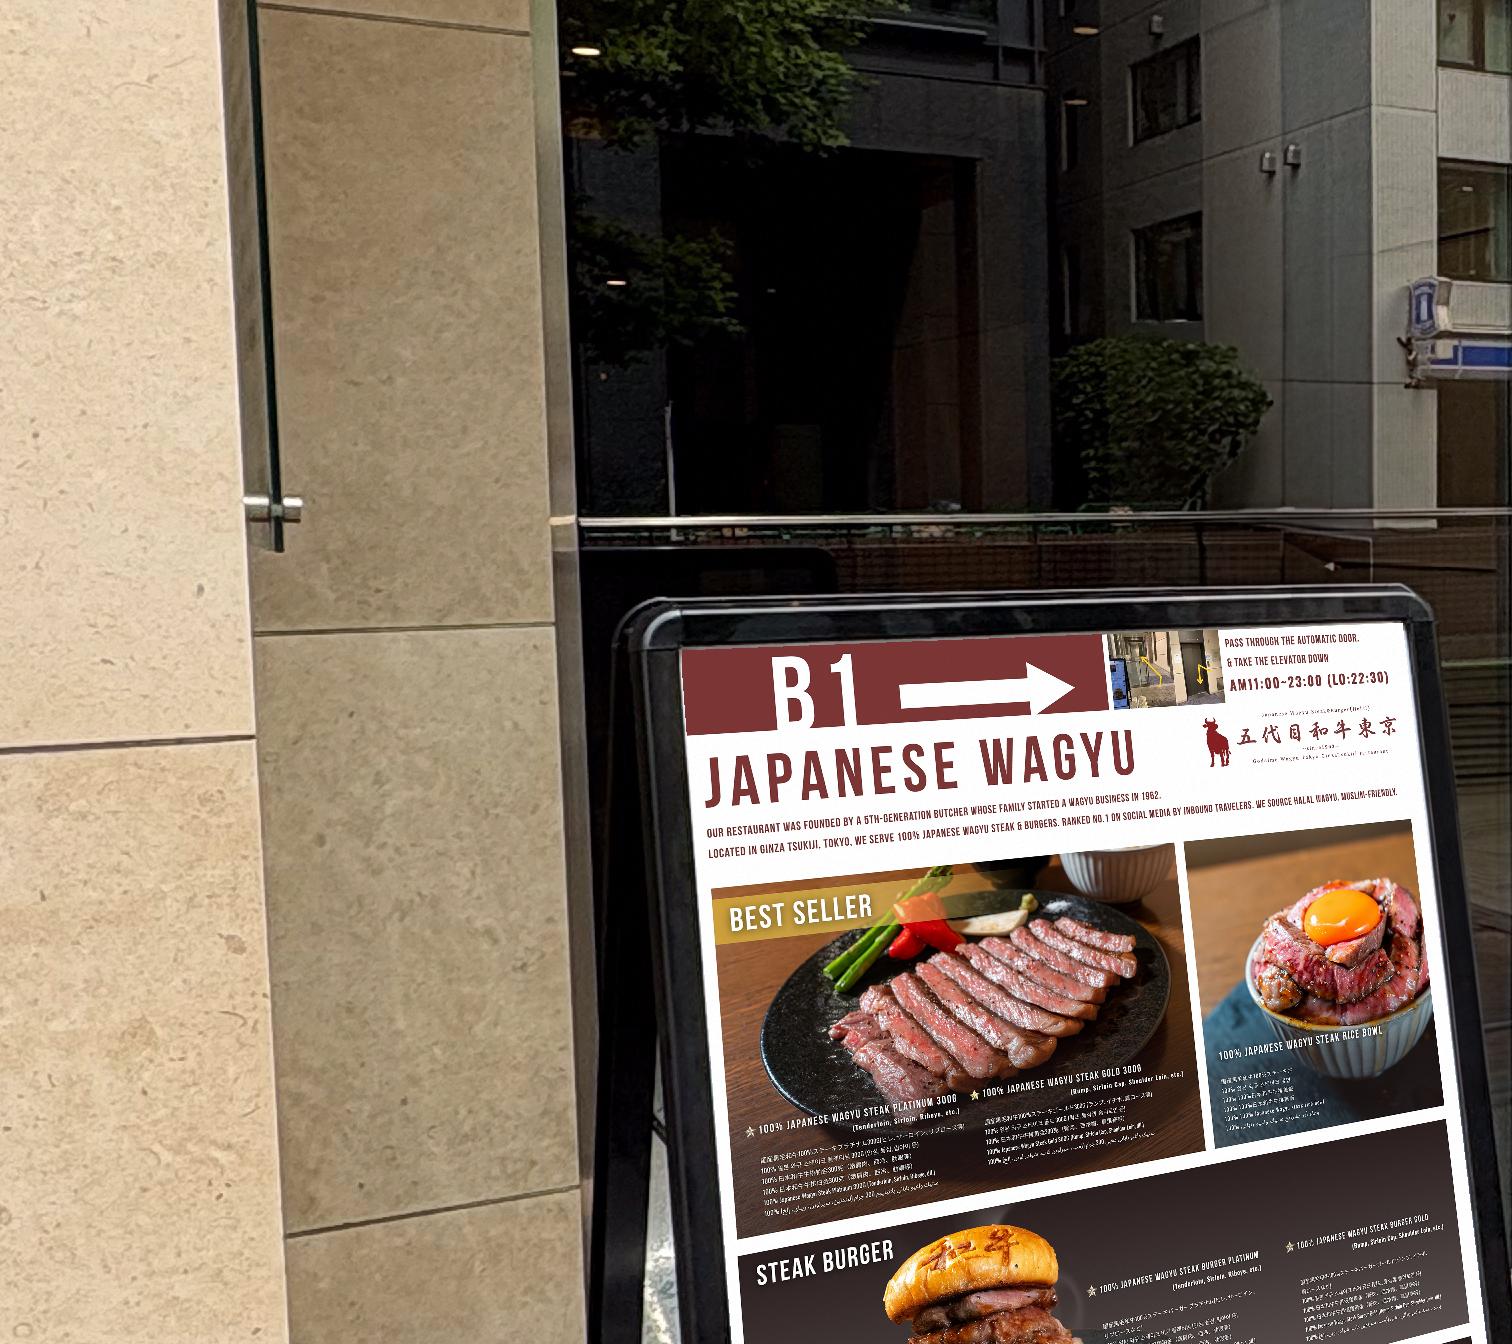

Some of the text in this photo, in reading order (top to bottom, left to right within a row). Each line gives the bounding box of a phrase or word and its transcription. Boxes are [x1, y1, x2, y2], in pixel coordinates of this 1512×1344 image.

[1224, 638, 1243, 647] PASS
[1245, 636, 1279, 647] THROUGH
[1281, 635, 1295, 645] THE
[1296, 634, 1336, 644] AUTOMATIC
[1226, 653, 1328, 667] & TAKE THE ELEVATOR DOWN
[1327, 670, 1389, 687] (LO:22:30)
[771, 653, 857, 730] B1
[1235, 715, 1398, 747] 五代目和牛東京
[705, 729, 1135, 808] JAPANESE WAGYU
[706, 790, 1161, 838] OUR RESTAURANT WAS FOUNDED BY A 5TH-GENERATION BUTCHER WHOSE FAMILY STARTED A WAGYU BUSINESS IN 1962.
[708, 845, 746, 859] LOCATED
[748, 844, 757, 855] IN
[759, 841, 785, 854] GINZA
[854, 834, 867, 845] WE
[869, 832, 894, 844] SERVE
[897, 829, 920, 841] 100%
[922, 826, 960, 839] JAPANESE
[962, 823, 989, 835] WAGYU
[991, 821, 1015, 833] STEAK
[1016, 820, 1022, 830] &
[1024, 817, 1059, 830] BURGERS.
[1061, 814, 1090, 826] RANKED
[1111, 812, 1120, 822] ON
[1122, 809, 1147, 821] SOCIAL
[1148, 807, 1171, 818] MEDIA
[1172, 806, 1181, 816] BY
[1183, 804, 1212, 815] INBOUND
[1255, 799, 1266, 809] WE
[1267, 797, 1292, 807] SOURCE
[1293, 795, 1314, 805] HALAL
[729, 892, 872, 932] BEST SELLER
[1218, 1025, 1382, 1060] 100% JAPANESE WAGYU STEAK RICE BOWL
[982, 1085, 1004, 1098] 100%
[1006, 1078, 1044, 1094] JAPANESE
[1047, 1074, 1073, 1087] WAGYU
[1075, 1070, 1099, 1083] STEAK
[1101, 1066, 1120, 1078] GOLD
[758, 1121, 782, 1135] 100%
[786, 1113, 828, 1130] JAPANESE
[831, 1108, 861, 1123] WAGYU
[863, 1104, 890, 1118] STEAK
[893, 1097, 933, 1113] PLATINUM
[755, 1238, 894, 1286] STEAK BURGER
[1120, 1274, 1153, 1289] JAPANESE
[1179, 1263, 1199, 1276] STEAK
[1201, 1257, 1226, 1271] BURGER
[1228, 1250, 1259, 1265] PLATINUM
